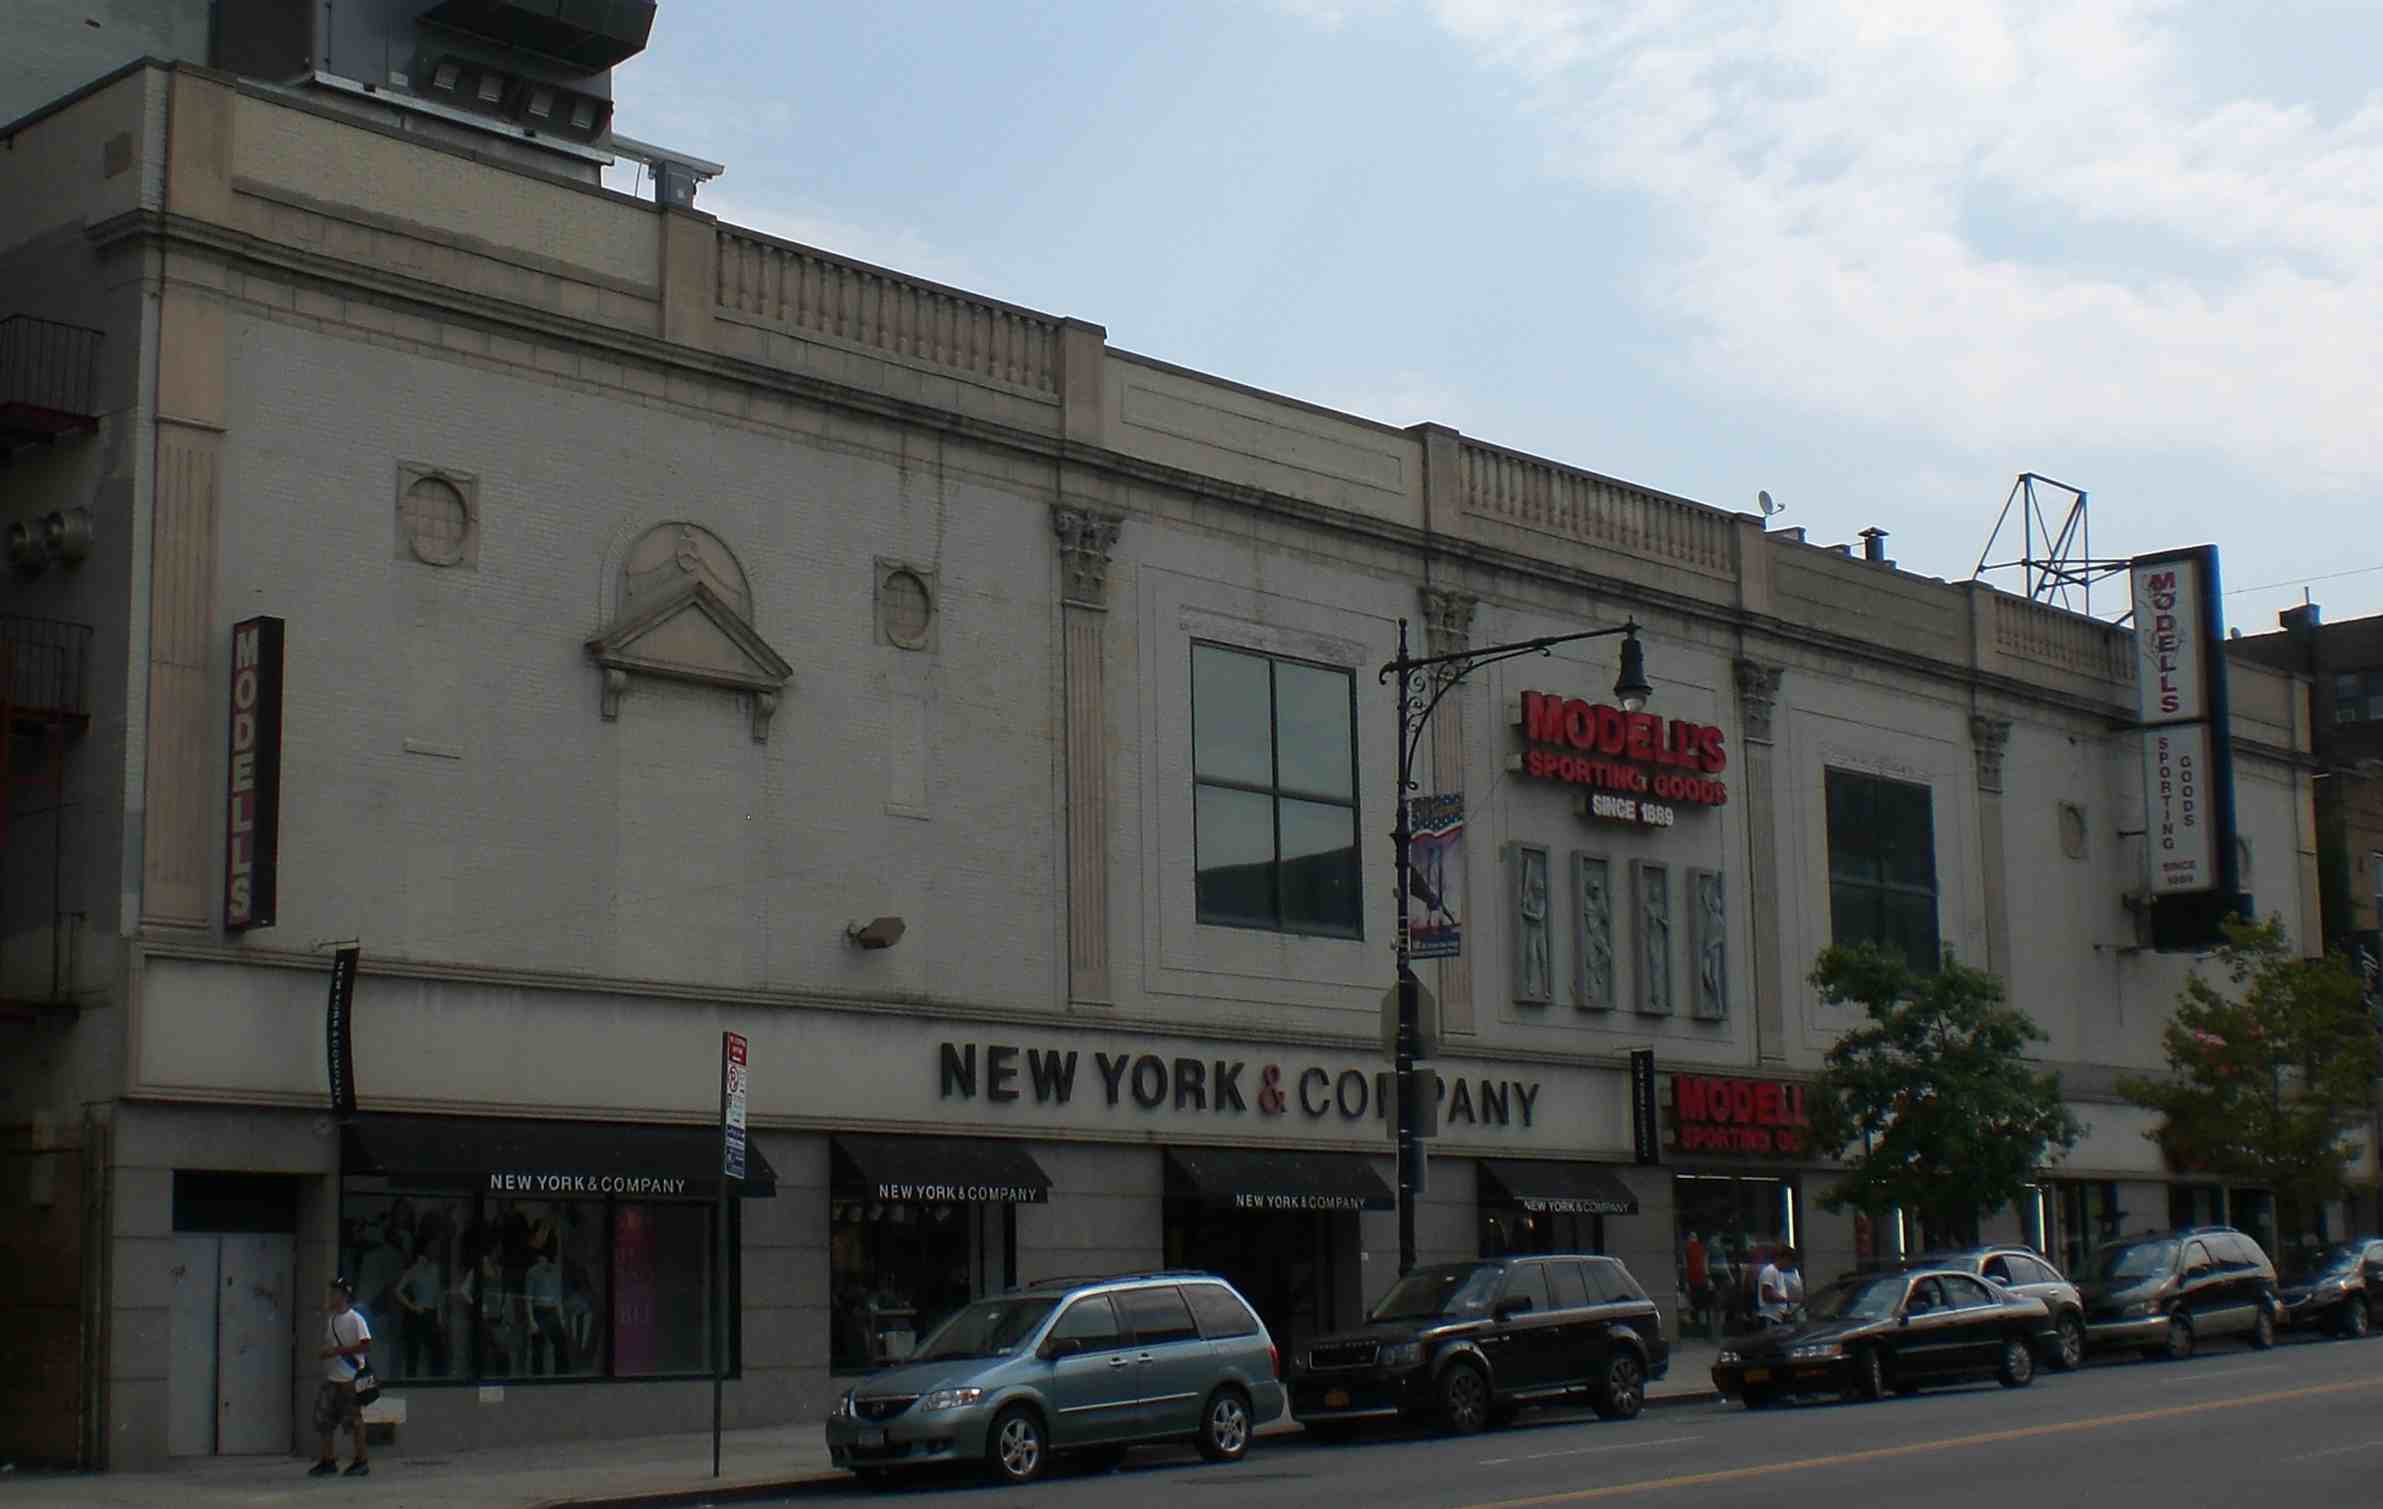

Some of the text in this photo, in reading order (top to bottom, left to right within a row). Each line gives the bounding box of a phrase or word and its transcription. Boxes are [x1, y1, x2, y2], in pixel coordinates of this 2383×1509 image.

[2150, 572, 2180, 713] MODELLS
[1522, 691, 1727, 773] MODELL'S
[229, 630, 258, 917] MODELLS
[1525, 752, 1727, 804] SPORTING GOODS
[2158, 737, 2195, 850] SPORTING GOODS
[1591, 794, 1675, 826] SINCE 1889
[940, 1043, 1541, 1128] NEW YORK & COANY
[1676, 1073, 1808, 1125] MODELL
[490, 1174, 532, 1190] NEW
[879, 1184, 912, 1200] NEW
[1235, 1193, 1264, 1208] NEW
